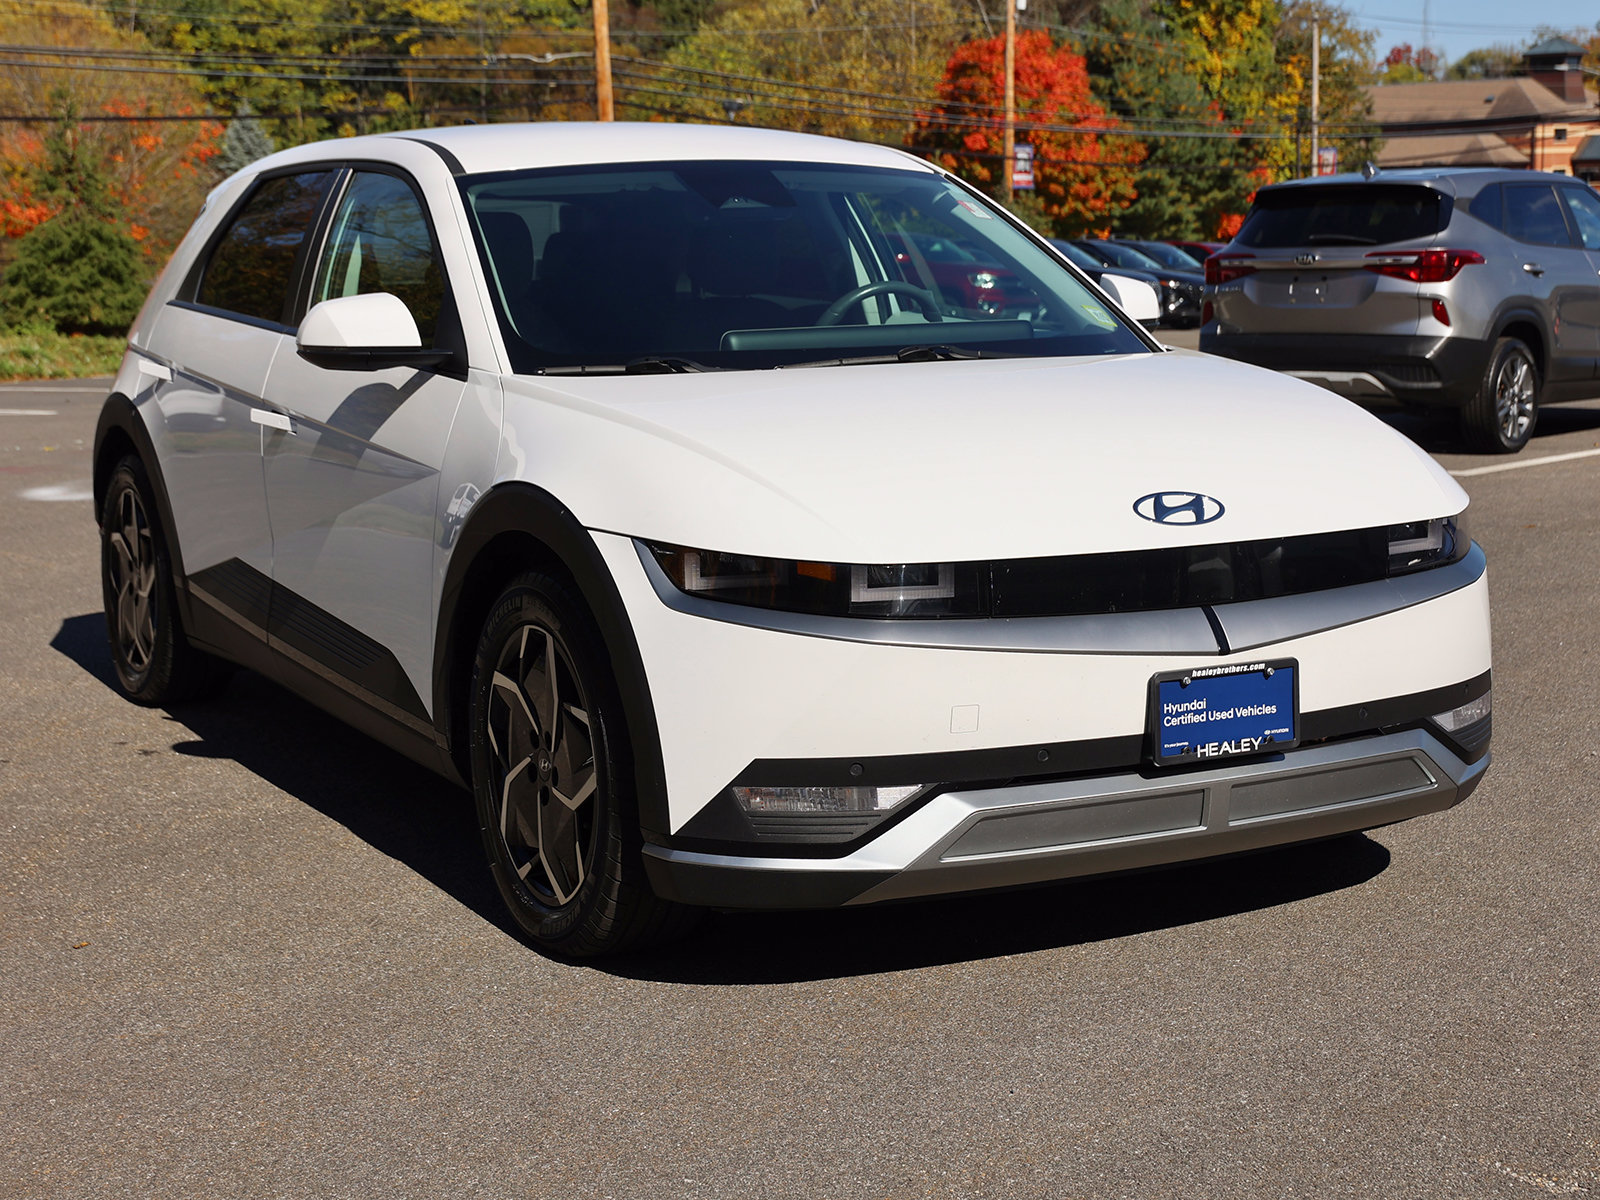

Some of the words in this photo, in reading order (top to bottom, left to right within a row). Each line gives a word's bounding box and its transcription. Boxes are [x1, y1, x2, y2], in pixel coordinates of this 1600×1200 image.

[1191, 662, 1266, 678] healeybrothers.com
[1163, 698, 1207, 715] Hyundai
[1163, 711, 1207, 727] Certified
[1208, 708, 1234, 721] Used
[1235, 704, 1277, 717] Vehicles
[1197, 736, 1263, 758] HEALEY
